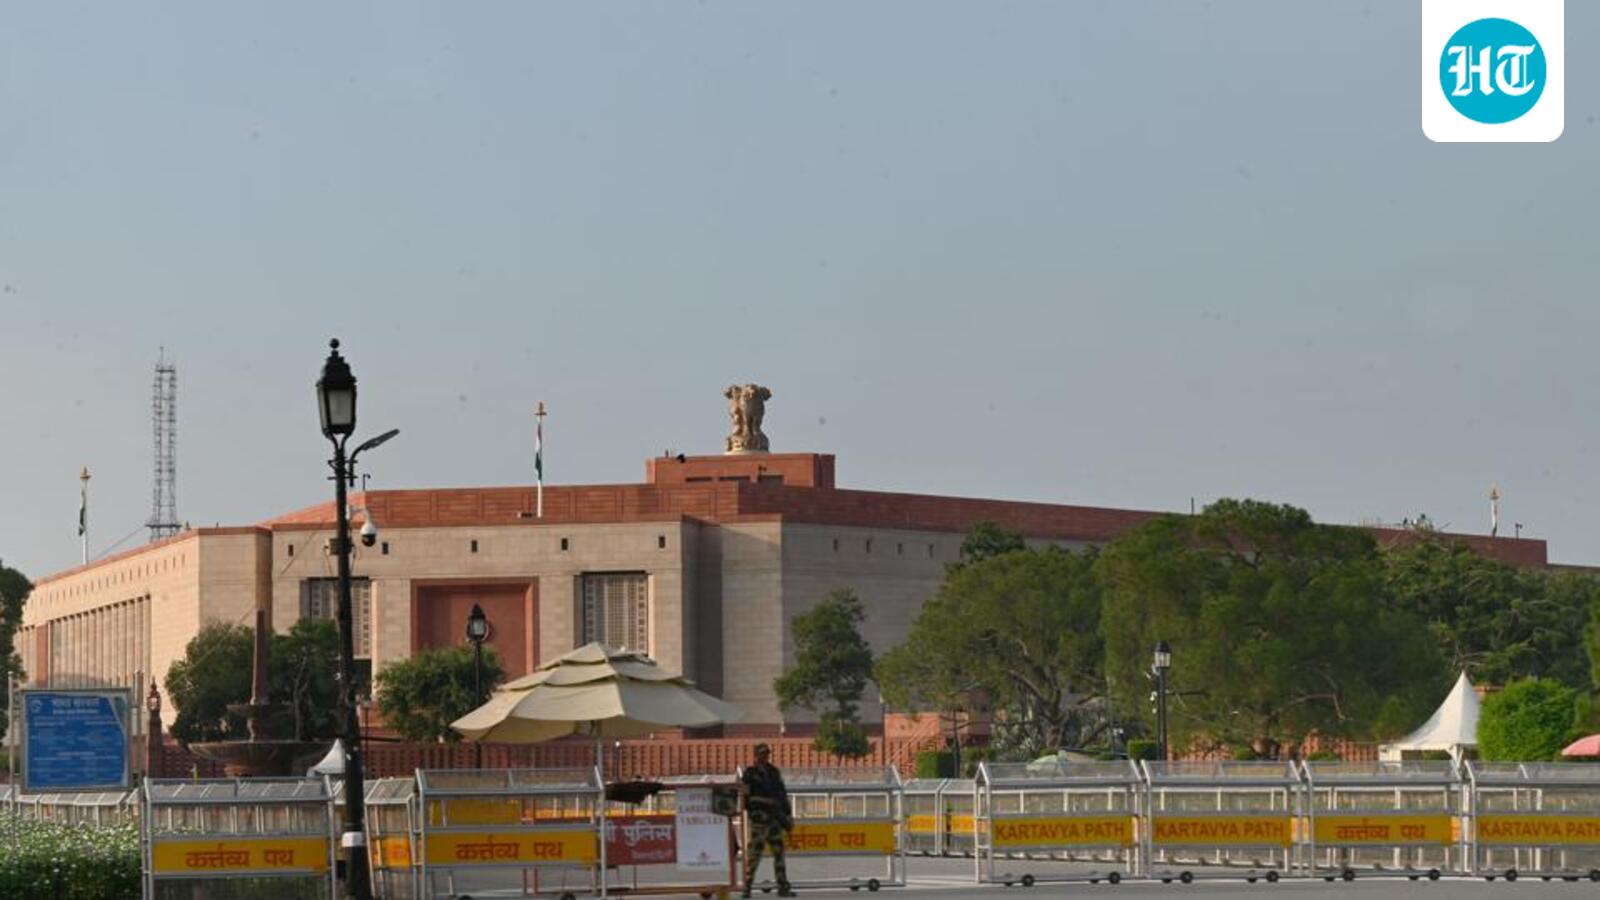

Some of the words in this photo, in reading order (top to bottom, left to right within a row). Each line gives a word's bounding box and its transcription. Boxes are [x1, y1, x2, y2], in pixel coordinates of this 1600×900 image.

[621, 820, 672, 847] पुलिस
[995, 823, 1080, 840] KARTAVYA
[1084, 821, 1125, 838] PATH
[1156, 822, 1240, 837] KARTAVYA
[1243, 821, 1284, 837] PATH
[1480, 821, 1562, 837] KARTAVYA
[263, 848, 294, 867] पथ
[533, 840, 564, 859] पथ
